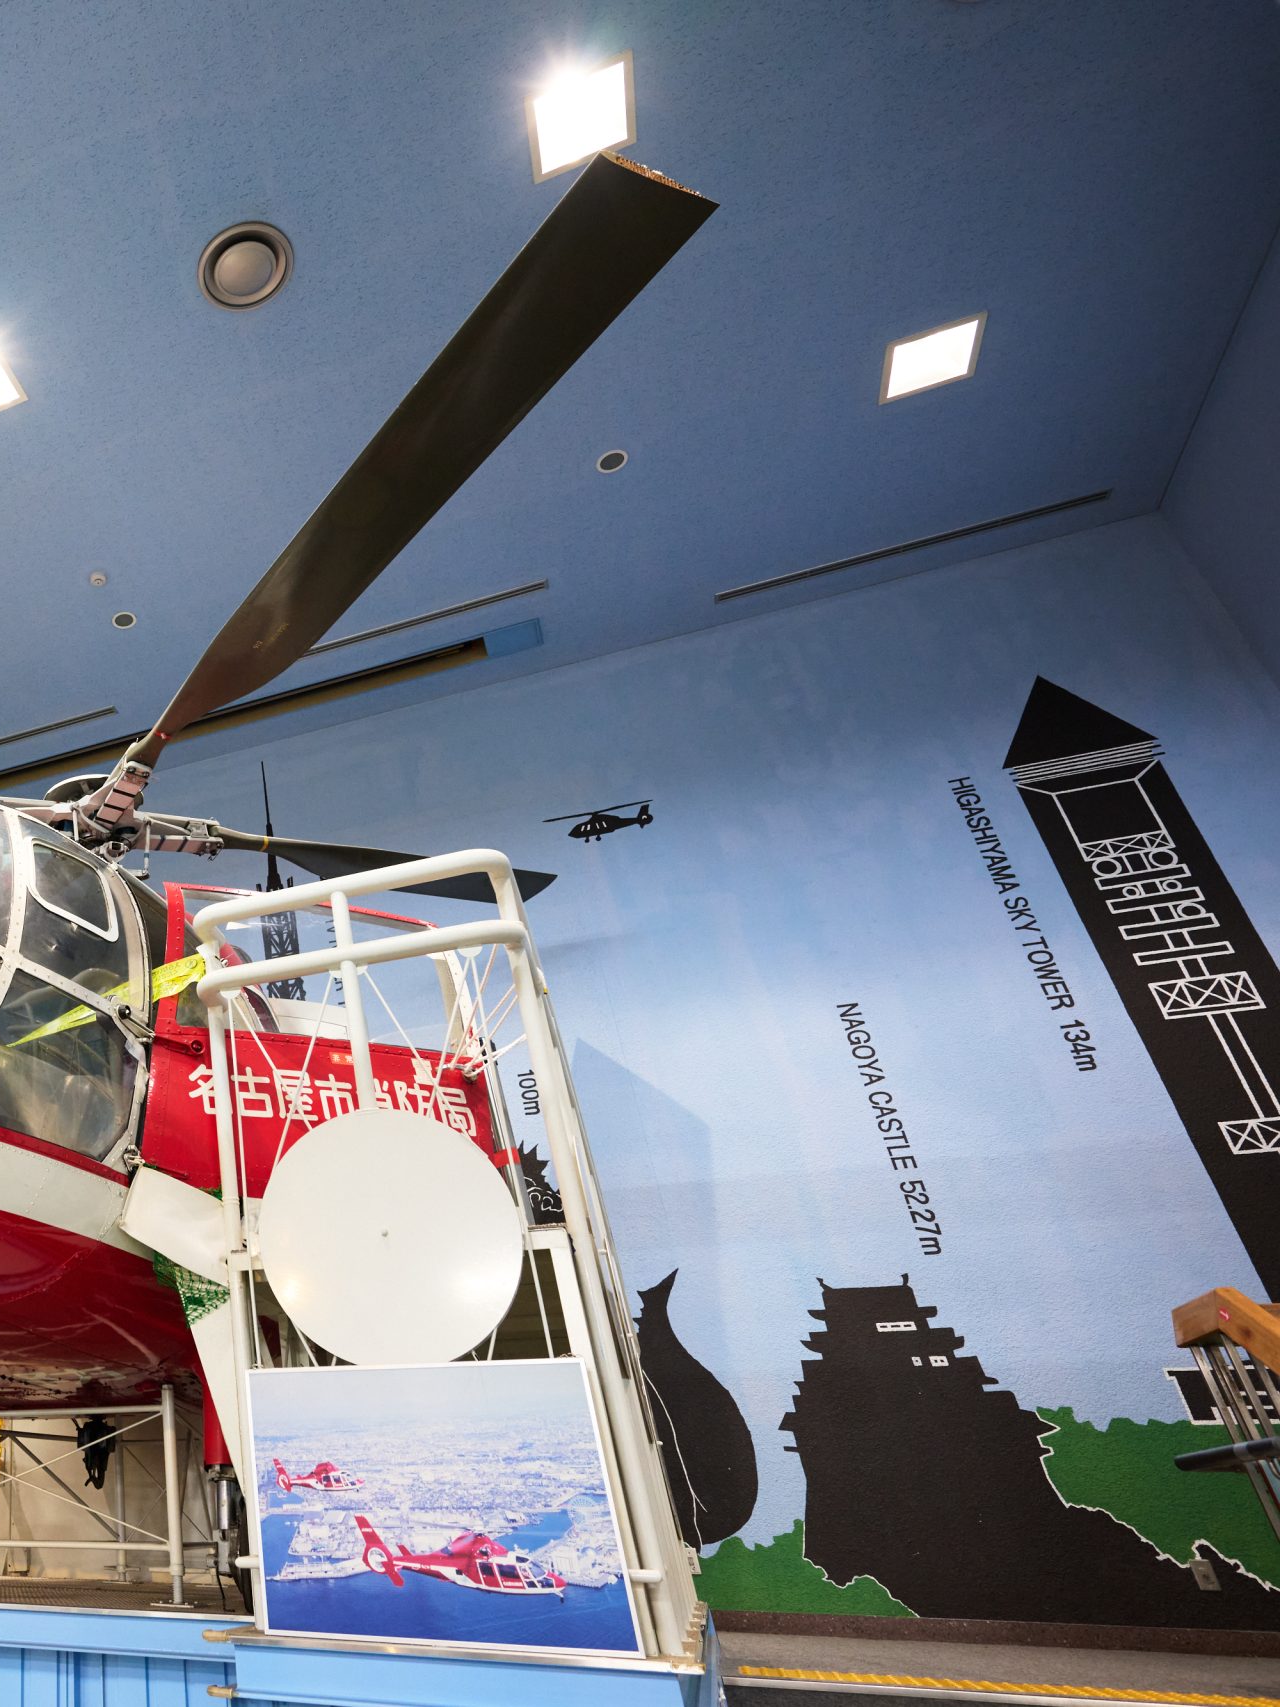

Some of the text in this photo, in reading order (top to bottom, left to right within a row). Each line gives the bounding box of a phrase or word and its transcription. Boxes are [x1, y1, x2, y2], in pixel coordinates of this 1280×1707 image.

[948, 776, 1097, 1072] HIGASHIYAMA SKY TOWER 134m
[517, 1069, 541, 1116] 100m
[836, 1002, 942, 1256] NAGOYA CASTLE 52.27m
